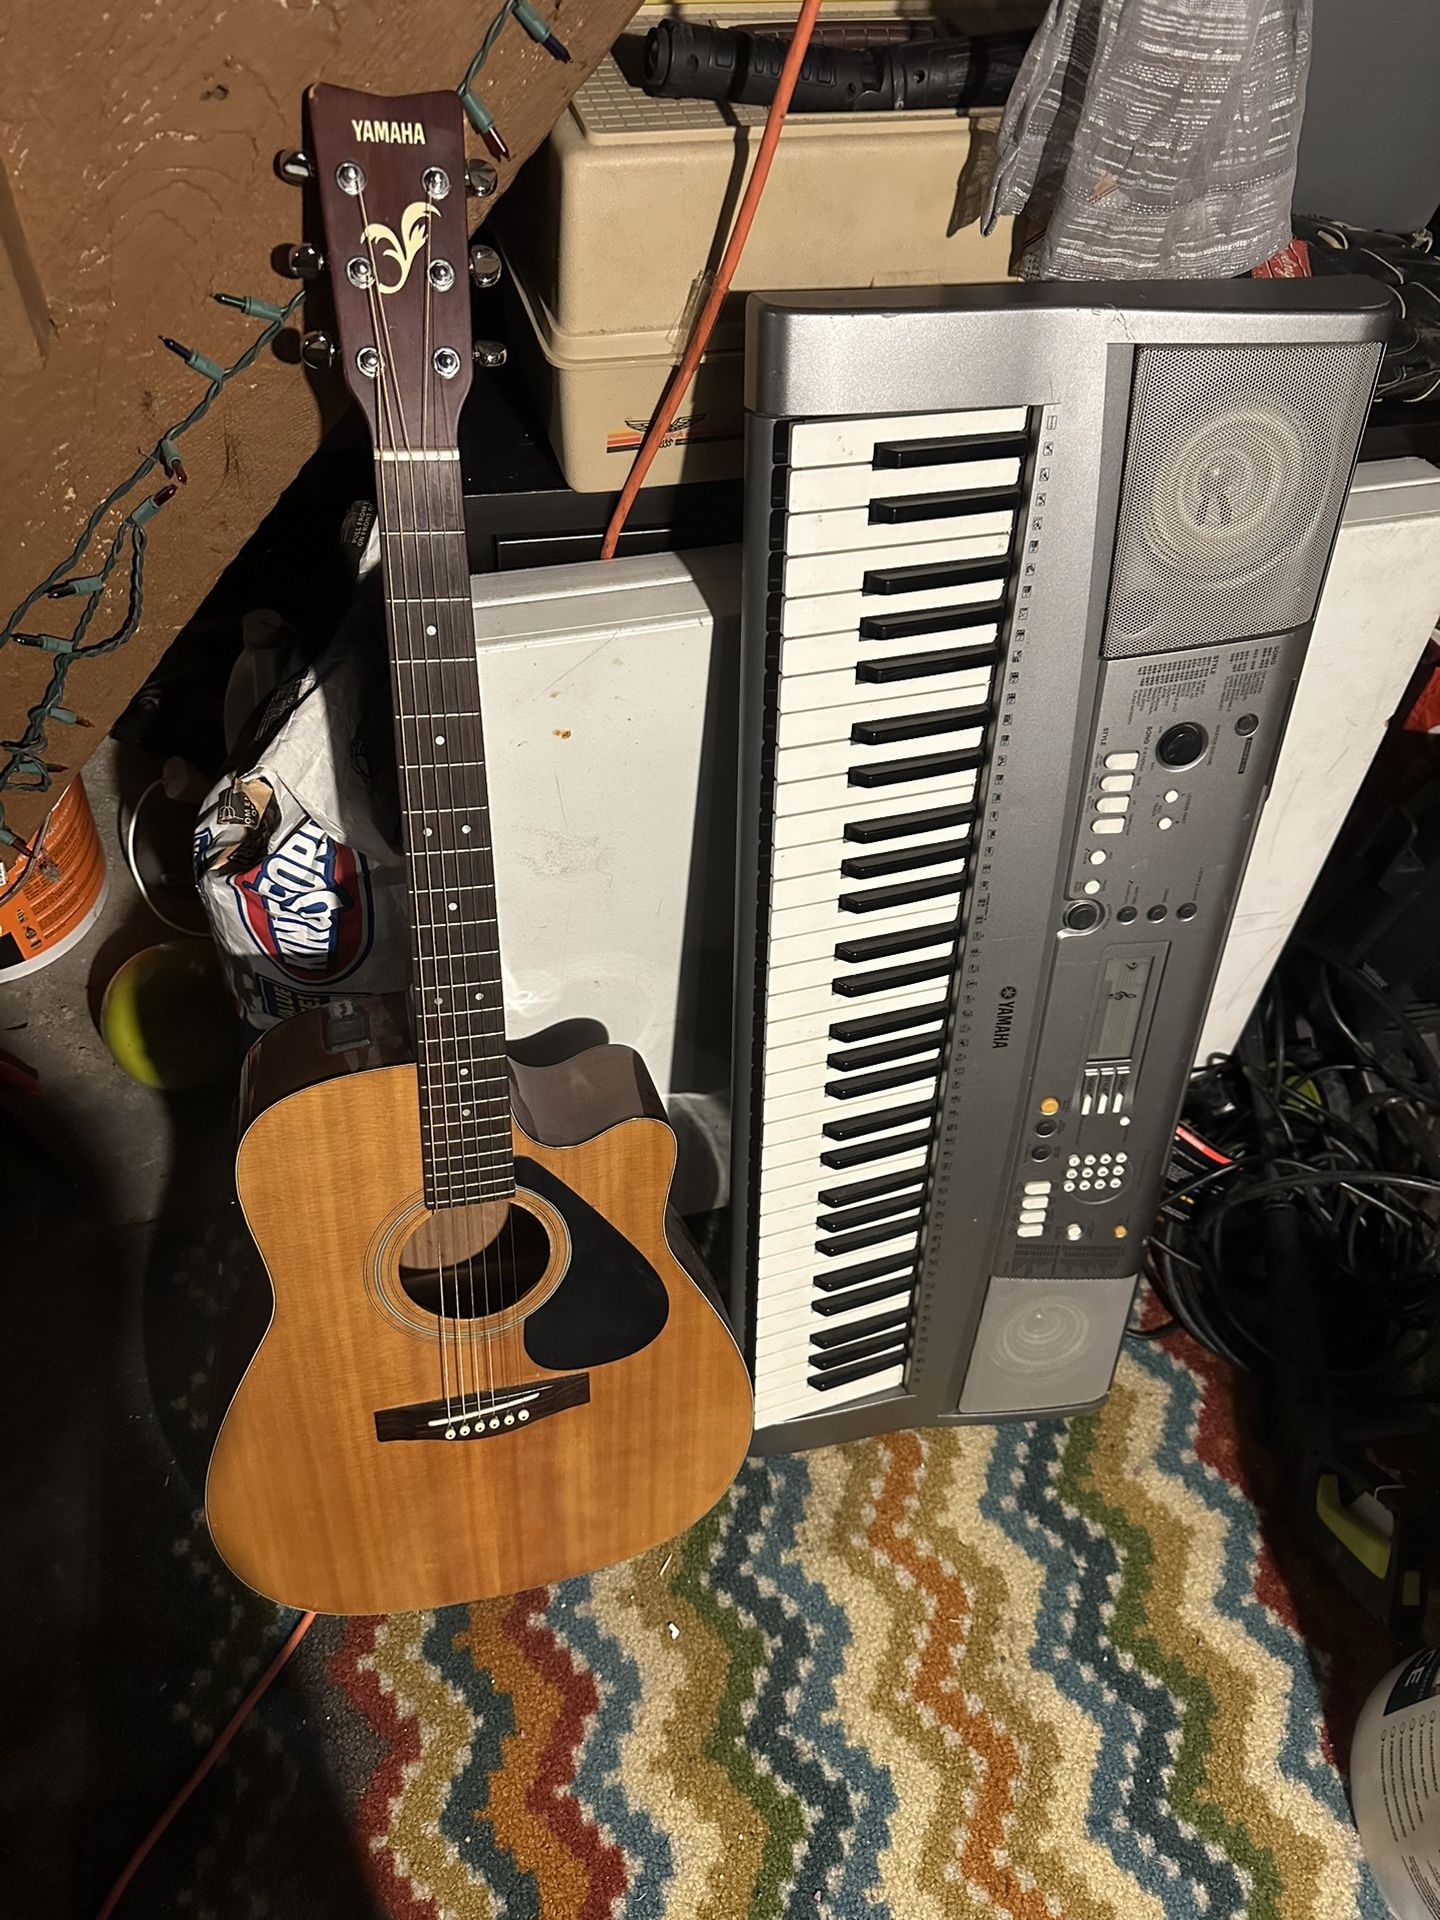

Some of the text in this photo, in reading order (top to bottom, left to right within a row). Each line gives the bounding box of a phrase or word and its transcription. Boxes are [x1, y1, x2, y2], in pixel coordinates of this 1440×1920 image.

[351, 119, 425, 145] YAMAHA
[1099, 727, 1110, 746] STYLE
[1143, 726, 1153, 745] SONG
[992, 1001, 1015, 1049] YAMAHA
